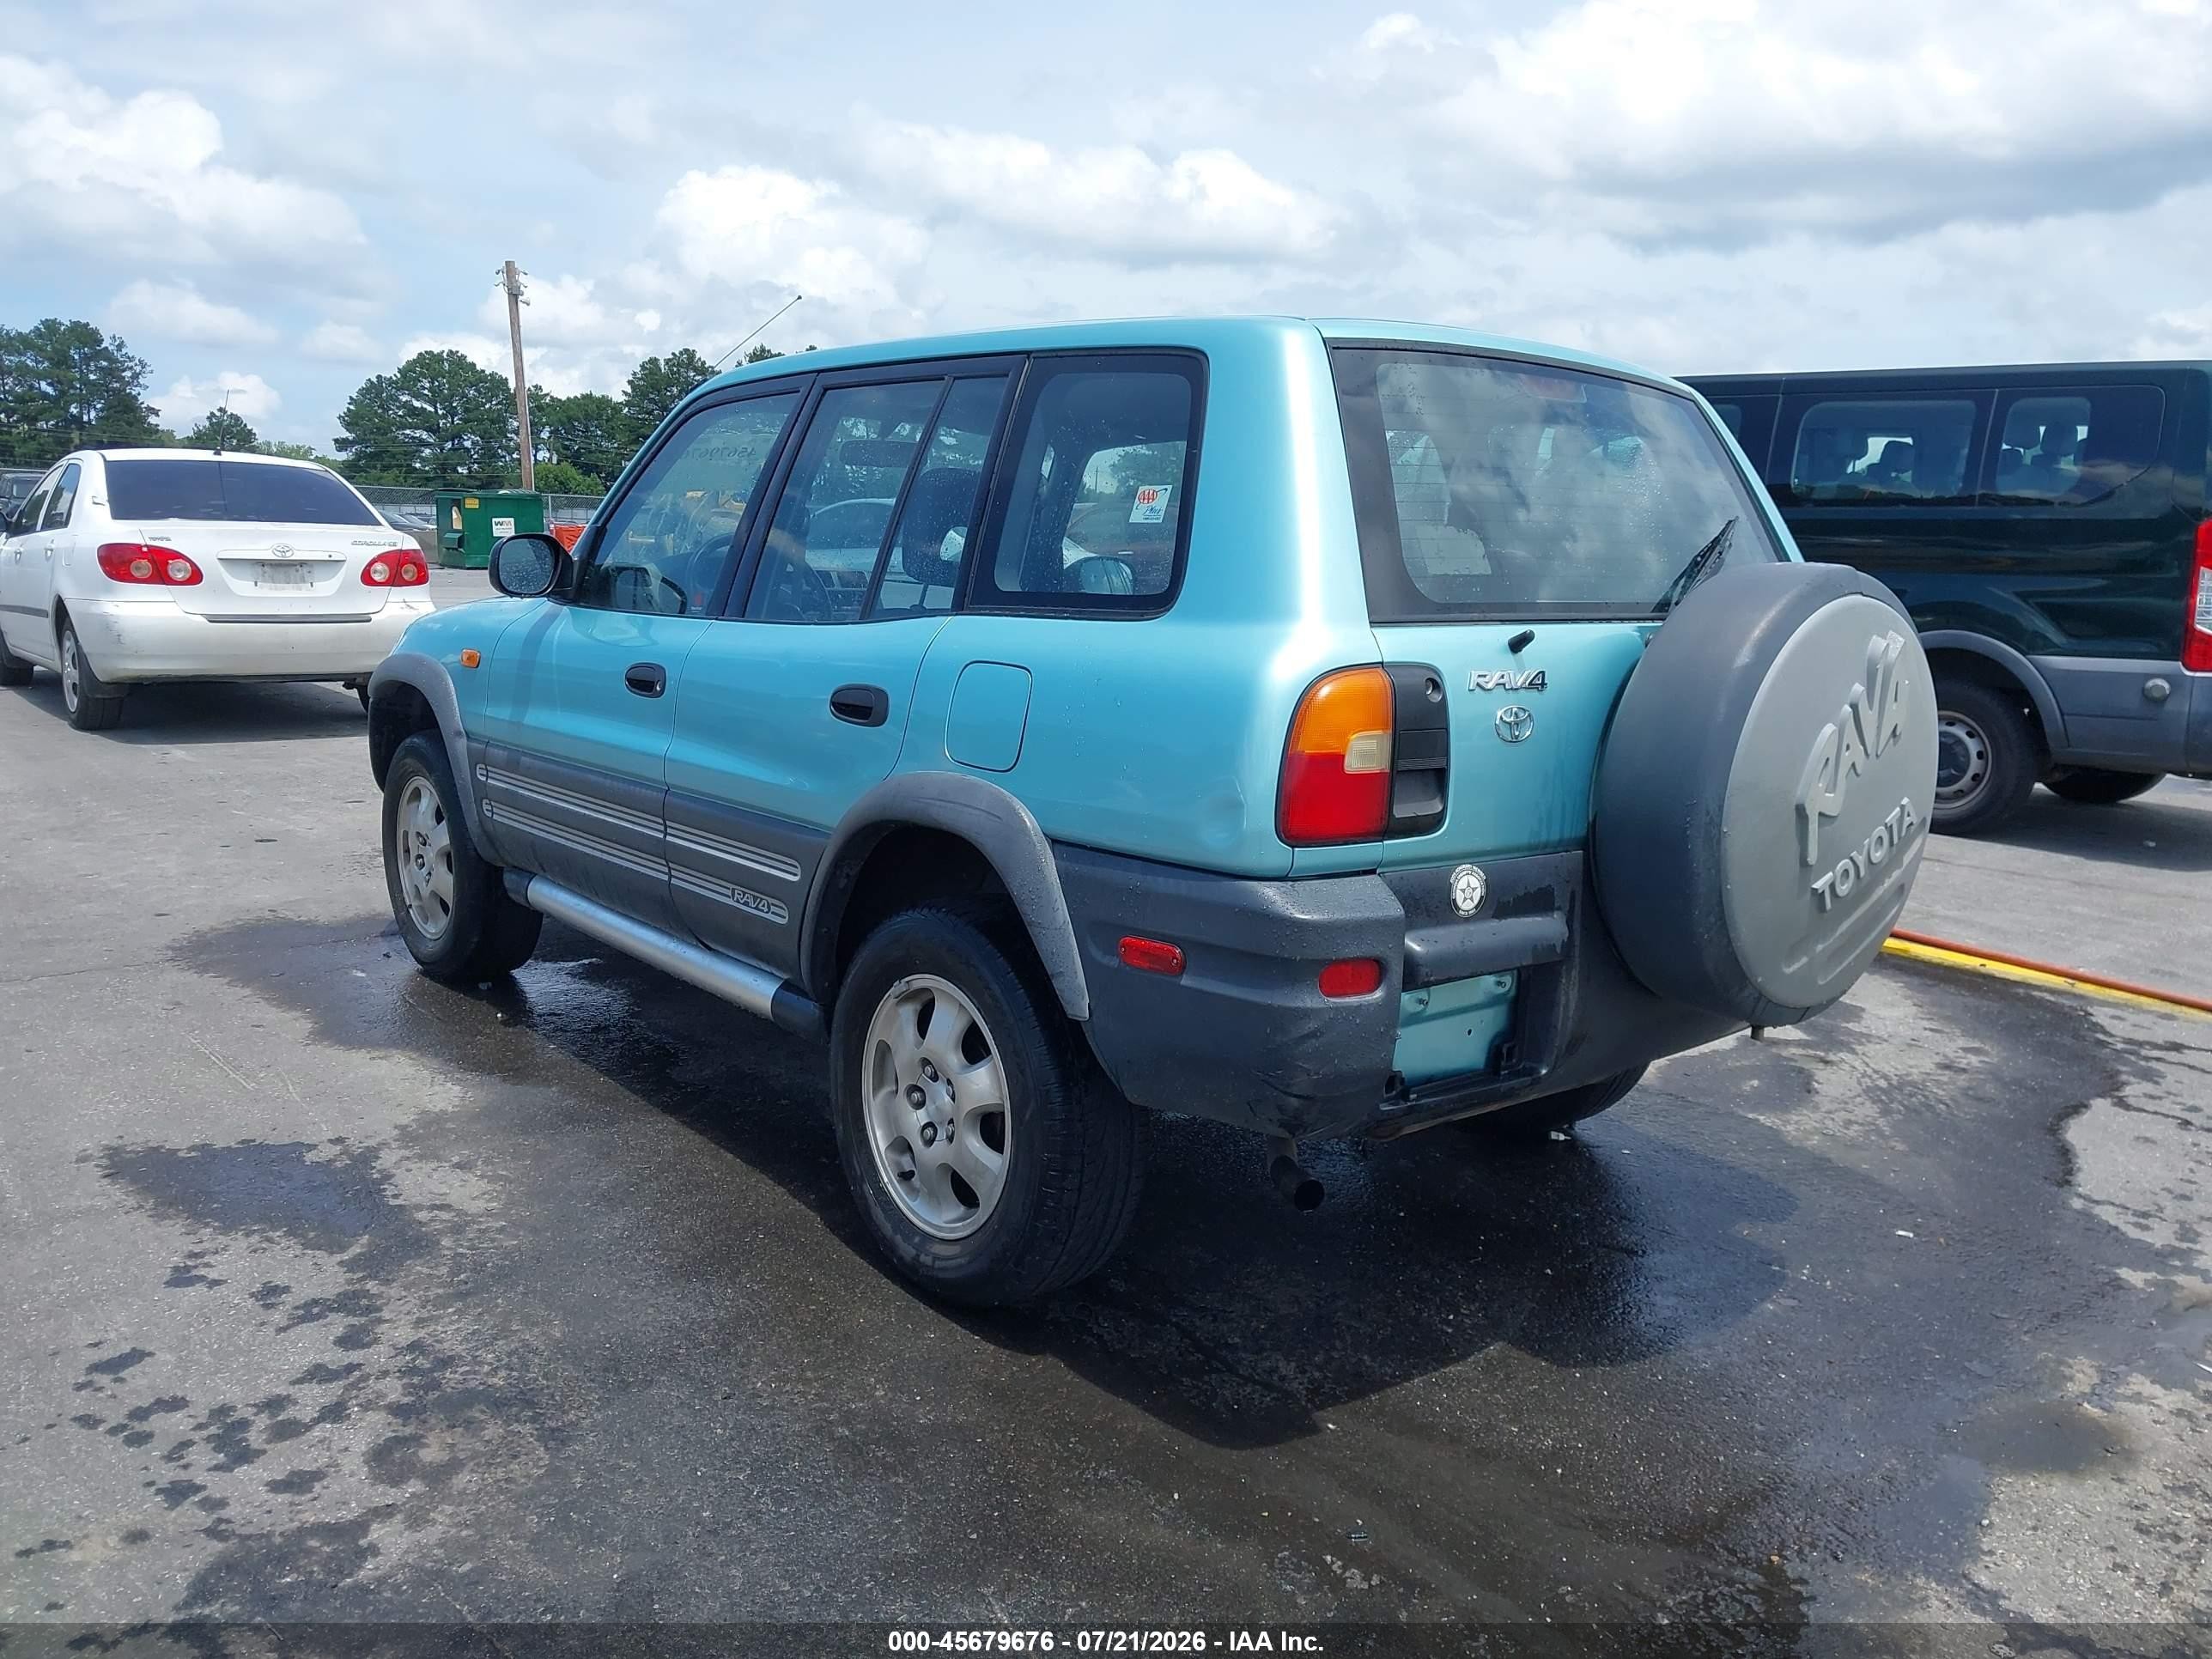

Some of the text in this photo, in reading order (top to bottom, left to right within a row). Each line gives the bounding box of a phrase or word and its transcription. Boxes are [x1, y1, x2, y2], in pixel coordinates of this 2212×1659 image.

[1467, 670, 1548, 691] RAV4
[1796, 629, 1910, 866] RAV4
[1811, 796, 1917, 912] TOYOTA
[733, 889, 769, 913] RAV4
